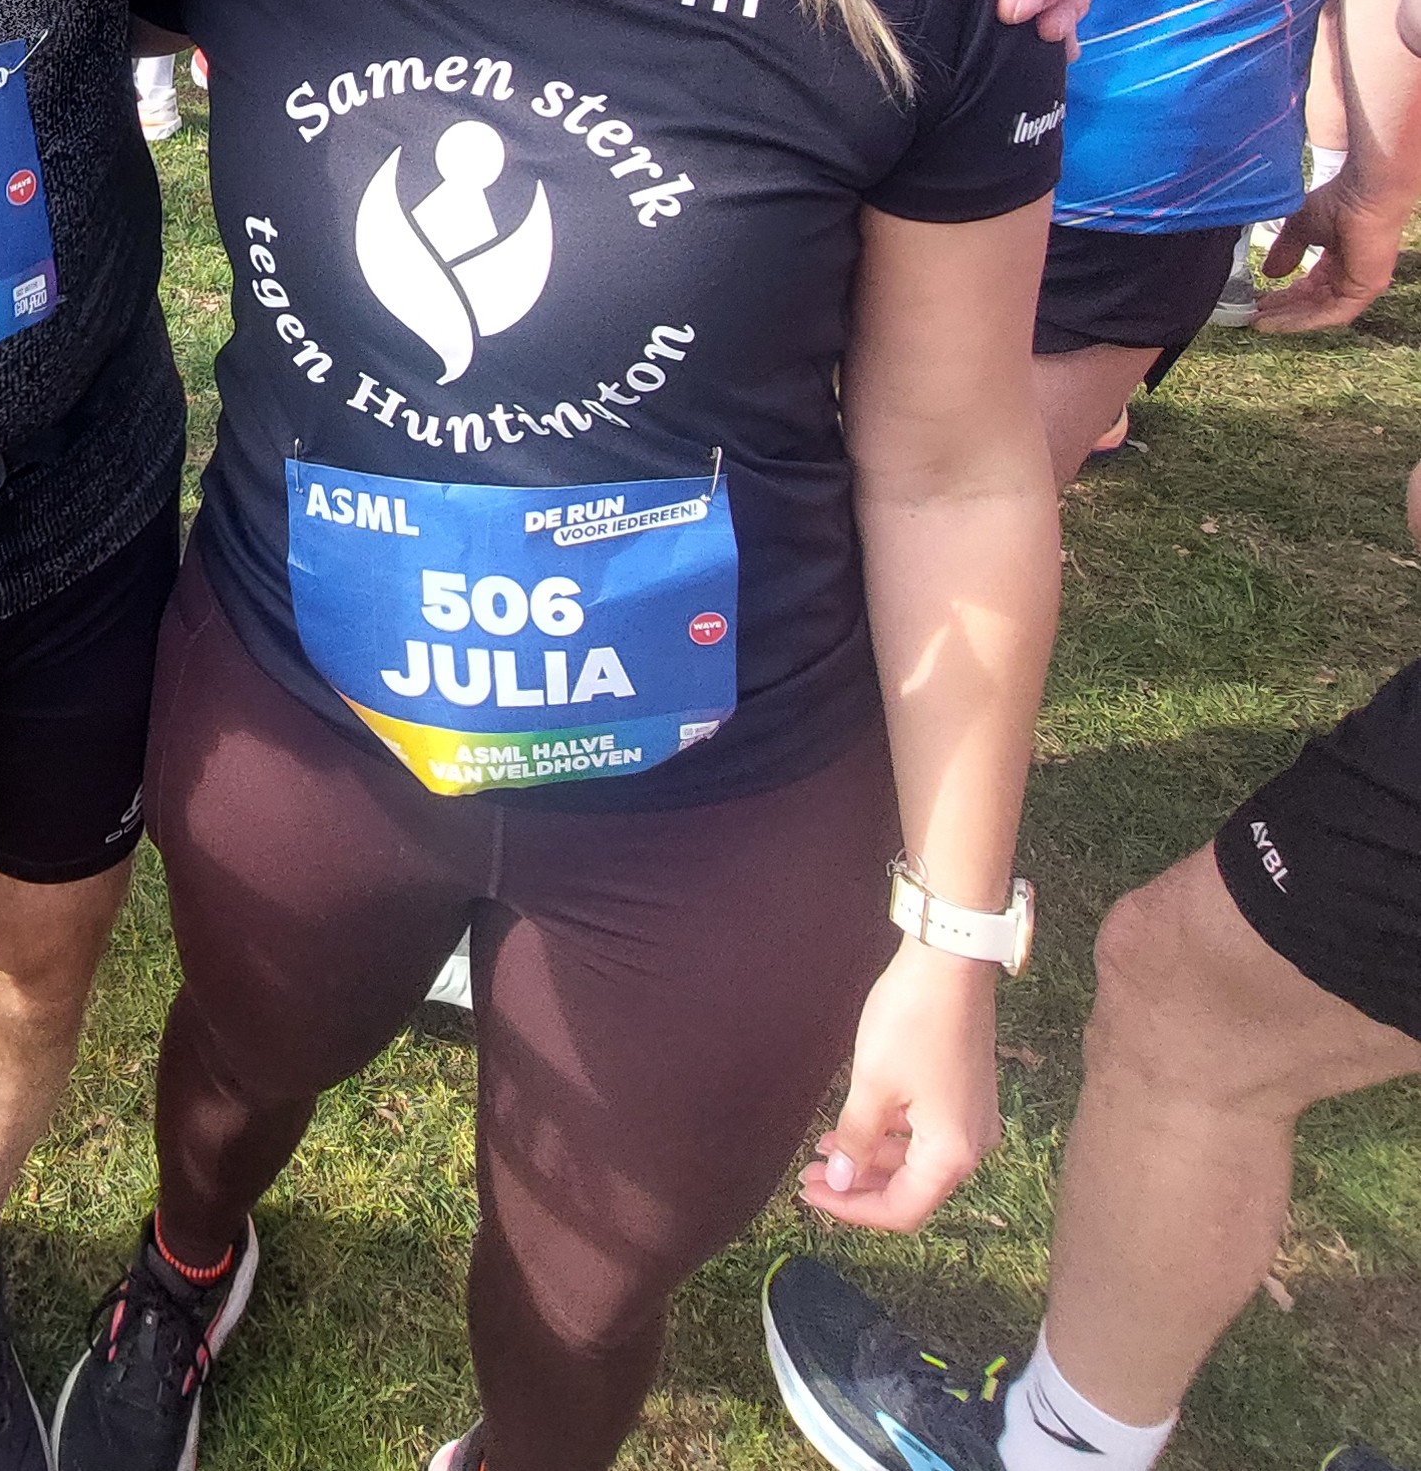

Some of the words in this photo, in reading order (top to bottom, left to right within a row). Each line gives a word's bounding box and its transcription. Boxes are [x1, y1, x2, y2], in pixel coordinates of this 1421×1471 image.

[285, 55, 516, 143] Samen
[531, 80, 695, 228] sterk
[9, 176, 32, 193] WAVE
[245, 216, 334, 383] tegen
[346, 324, 695, 453] Huntington
[305, 483, 420, 537] ASML
[524, 508, 562, 533] DE
[566, 495, 625, 525] RUN
[560, 523, 608, 542] VOOR
[611, 503, 698, 533] IEDEREEN!
[420, 569, 585, 637] 506
[693, 620, 722, 632] WAVE
[380, 640, 637, 708] JULIA
[428, 758, 482, 784] VAN
[485, 747, 642, 782] VELDHOVEN
[455, 744, 528, 765] ASML
[532, 733, 615, 760] HALVE
[1250, 821, 1288, 894] AYBL
